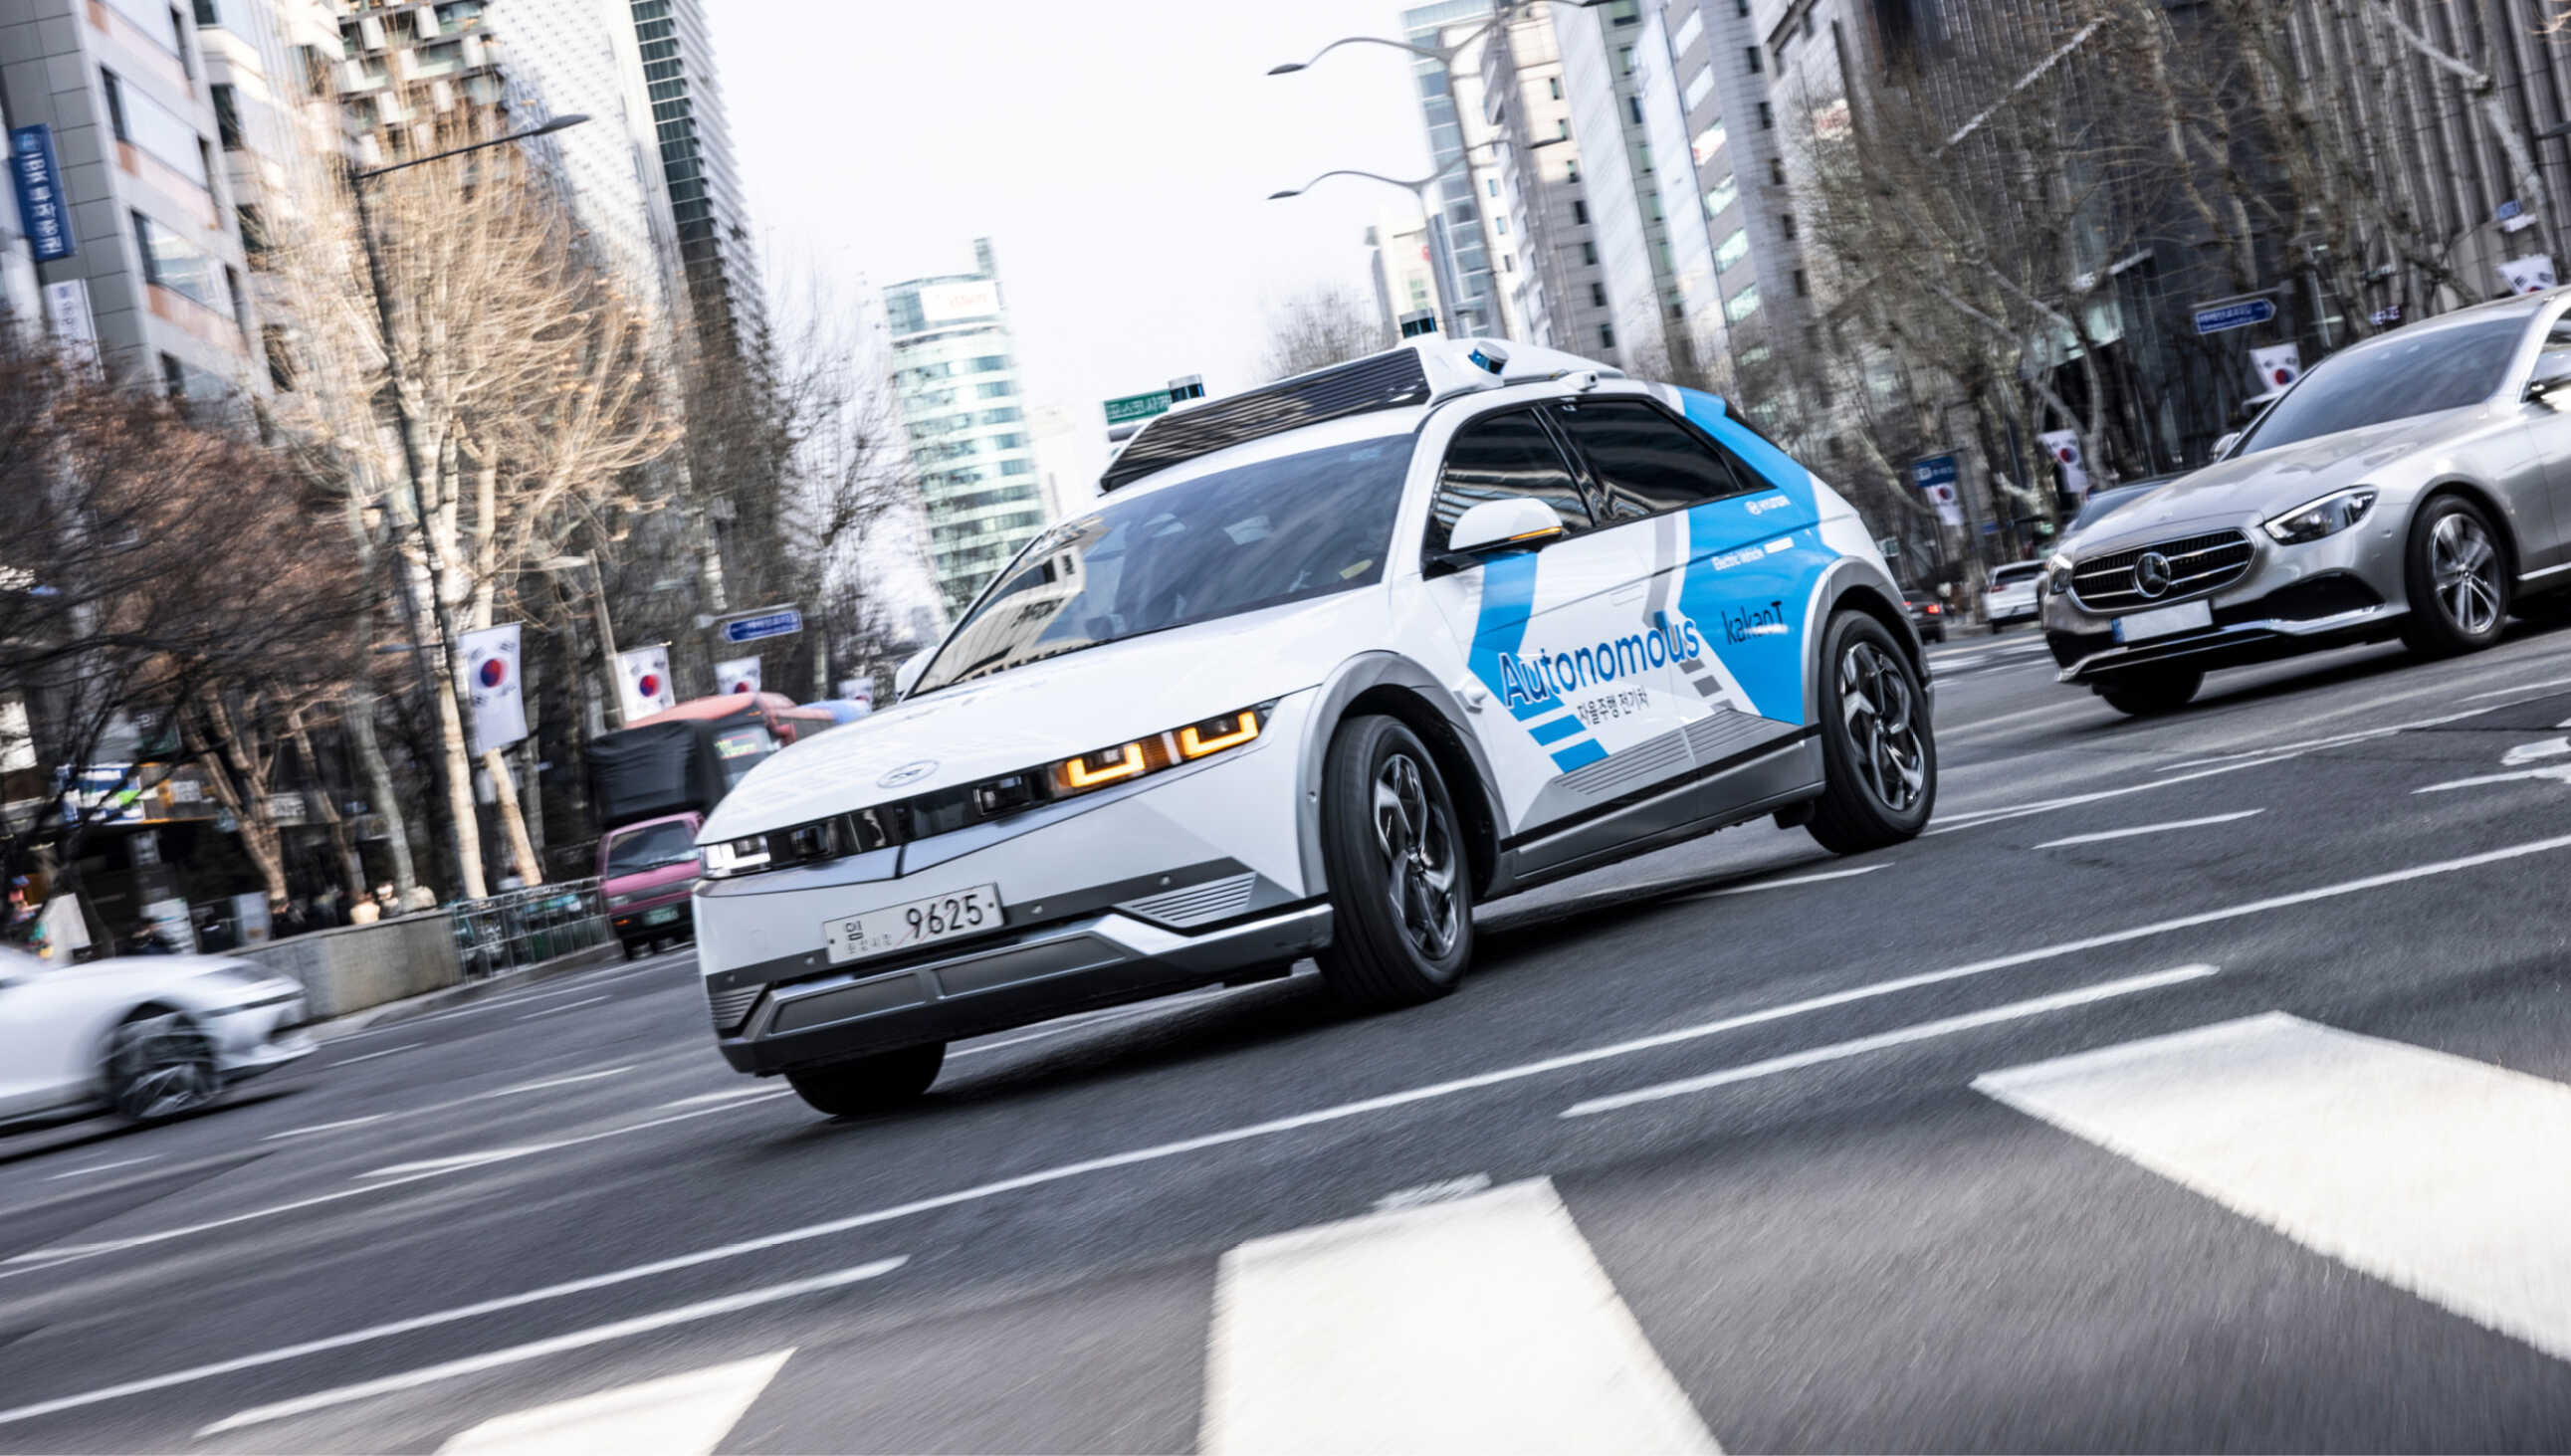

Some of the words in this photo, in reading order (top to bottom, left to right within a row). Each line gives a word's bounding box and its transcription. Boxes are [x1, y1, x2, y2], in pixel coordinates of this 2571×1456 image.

[1499, 615, 1700, 707] Autonomous
[1577, 694, 1617, 726] 자율주행
[1617, 685, 1649, 715] 전기차
[845, 921, 864, 940] 임
[906, 894, 983, 938] 9625
